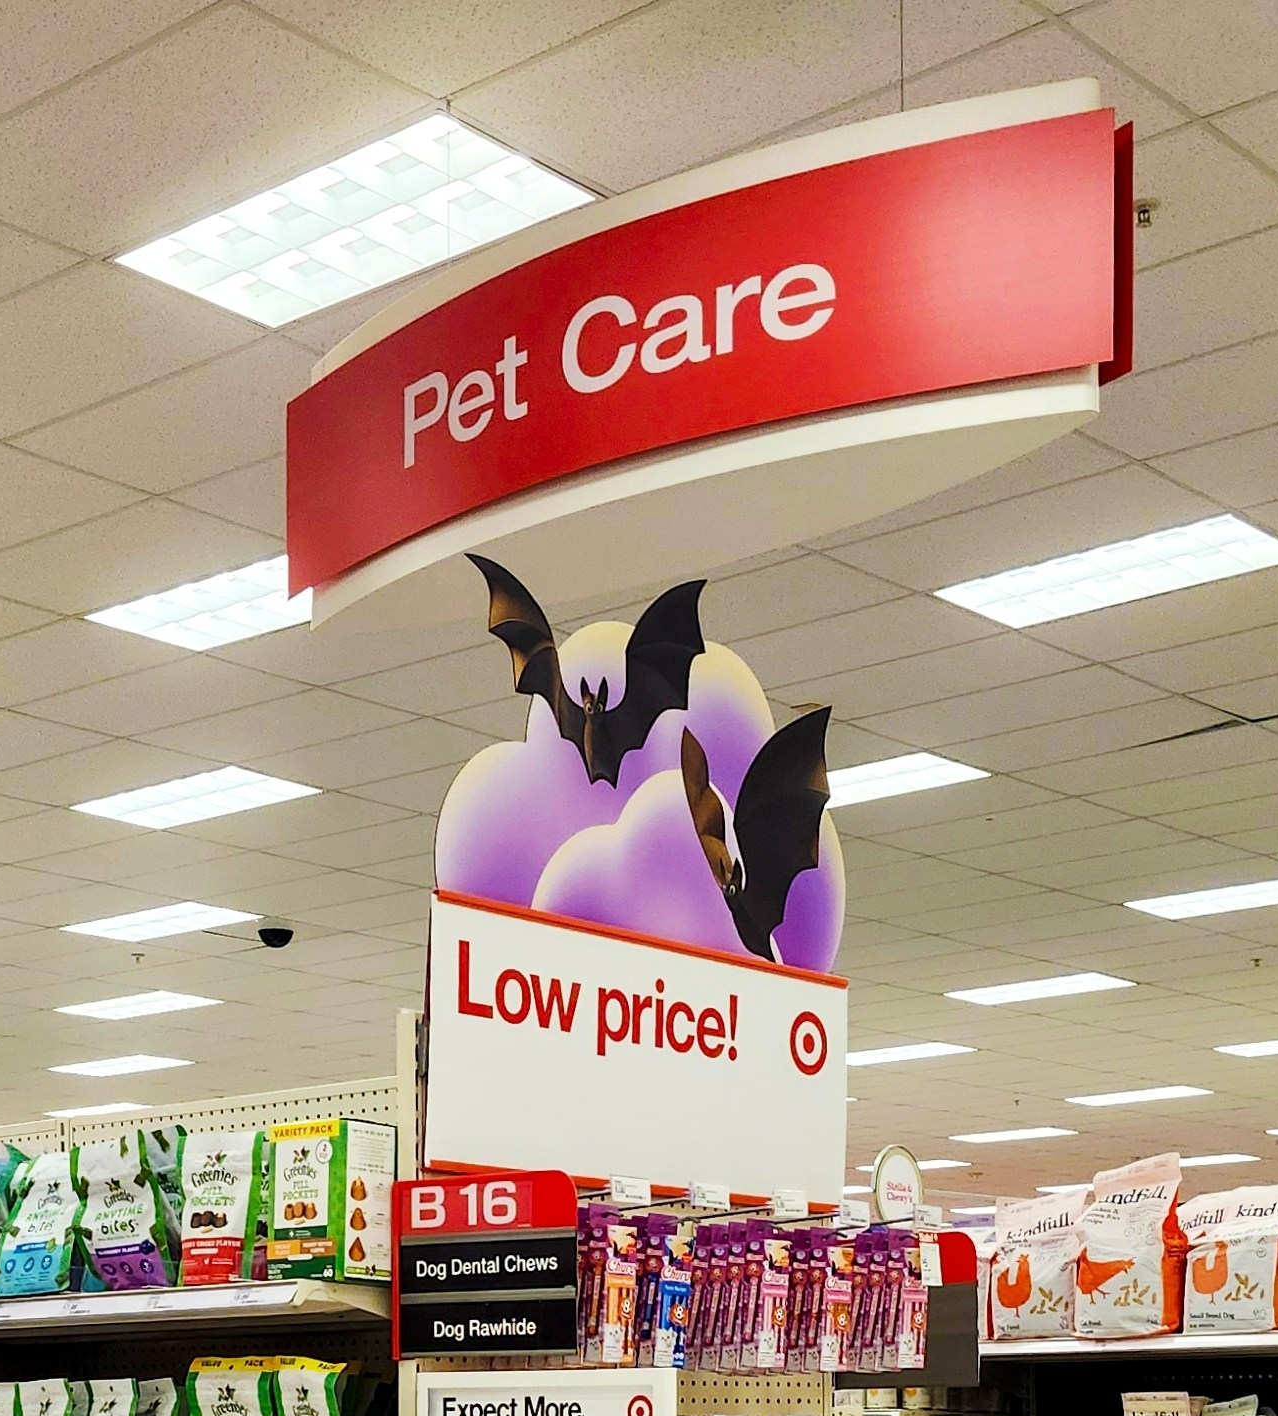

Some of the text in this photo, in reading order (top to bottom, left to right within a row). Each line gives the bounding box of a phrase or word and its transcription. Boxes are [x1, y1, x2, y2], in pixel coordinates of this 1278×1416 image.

[403, 263, 837, 470] Pet Care
[457, 939, 740, 1061] Low price!
[273, 1125, 333, 1138] VARIETY PACK
[886, 1181, 906, 1191] Stella
[411, 1179, 518, 1229] B 16
[415, 1253, 558, 1279] Dog Dental Chews
[433, 1317, 537, 1340] Dog Rawhide
